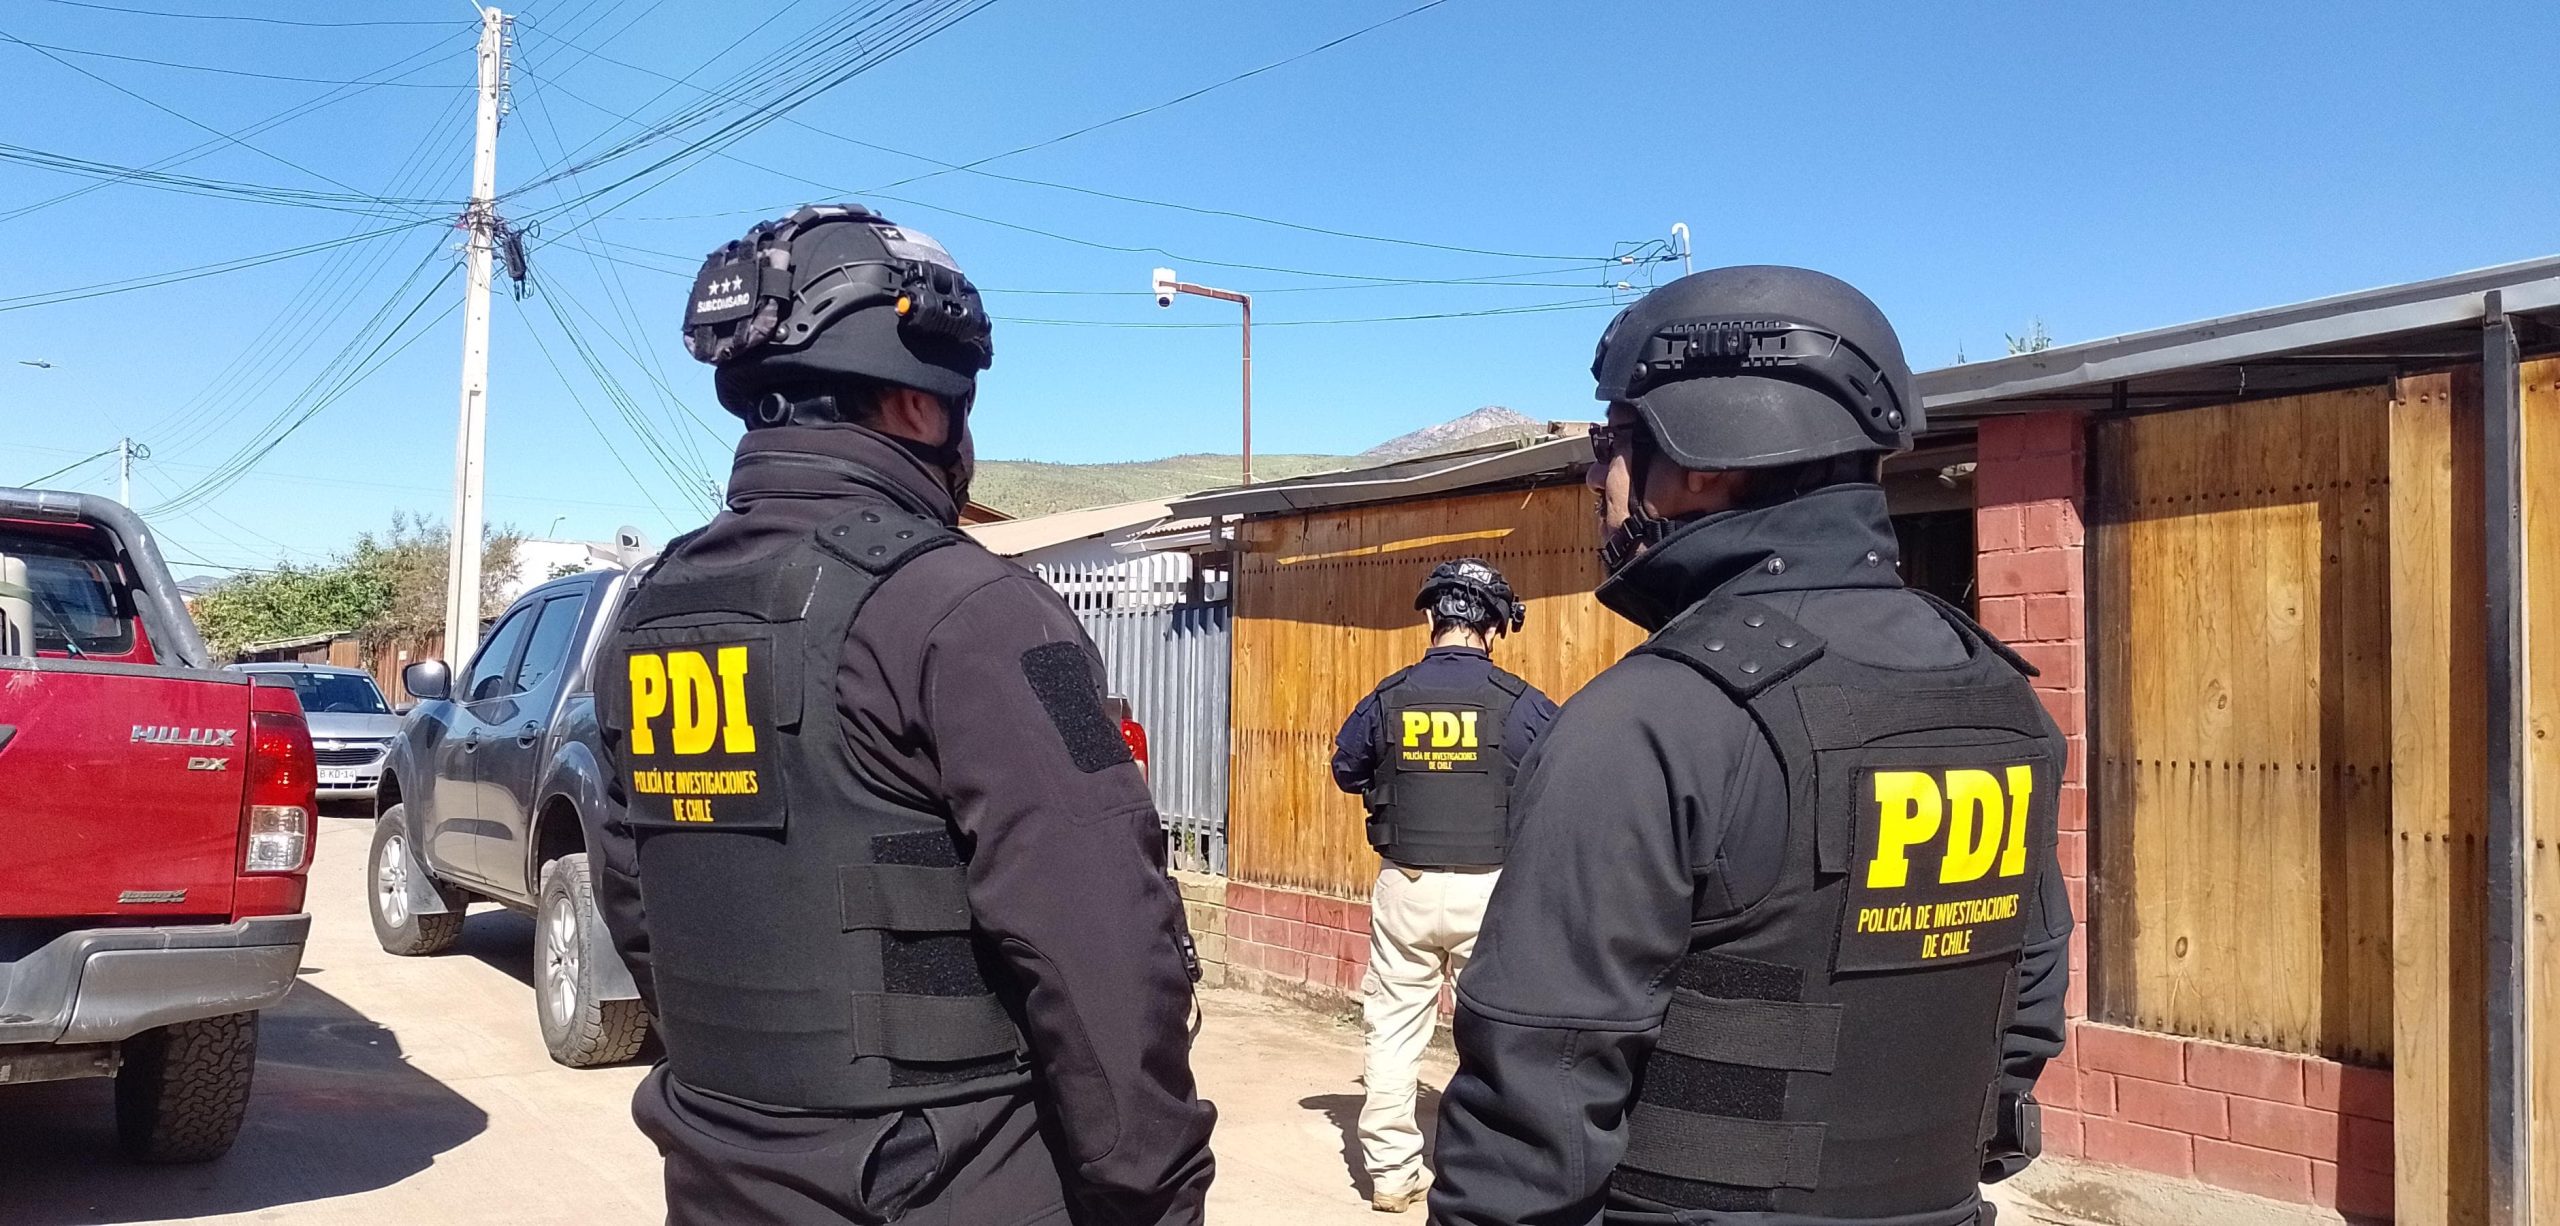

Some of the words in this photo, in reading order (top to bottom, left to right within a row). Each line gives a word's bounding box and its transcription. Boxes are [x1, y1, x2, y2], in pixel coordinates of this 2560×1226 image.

[629, 646, 756, 755] PDI
[130, 725, 238, 747] HILUX
[1402, 711, 1478, 747] PDI
[187, 756, 230, 770] DX
[1424, 751, 1431, 761] DE
[1428, 761, 1437, 770] DE
[633, 767, 664, 794] POLICÍA
[663, 771, 676, 794] DE
[675, 770, 759, 795] INVESTIGACIONES
[672, 798, 687, 822] DE
[686, 798, 715, 822] CHILE
[1867, 765, 2032, 888] PDI
[1857, 902, 1912, 933] POLICÍA
[1914, 904, 1933, 930] DE
[1933, 893, 2020, 929] INVESTIGACIONES
[1921, 933, 1940, 959] DE
[1940, 929, 1973, 957] CHILE
